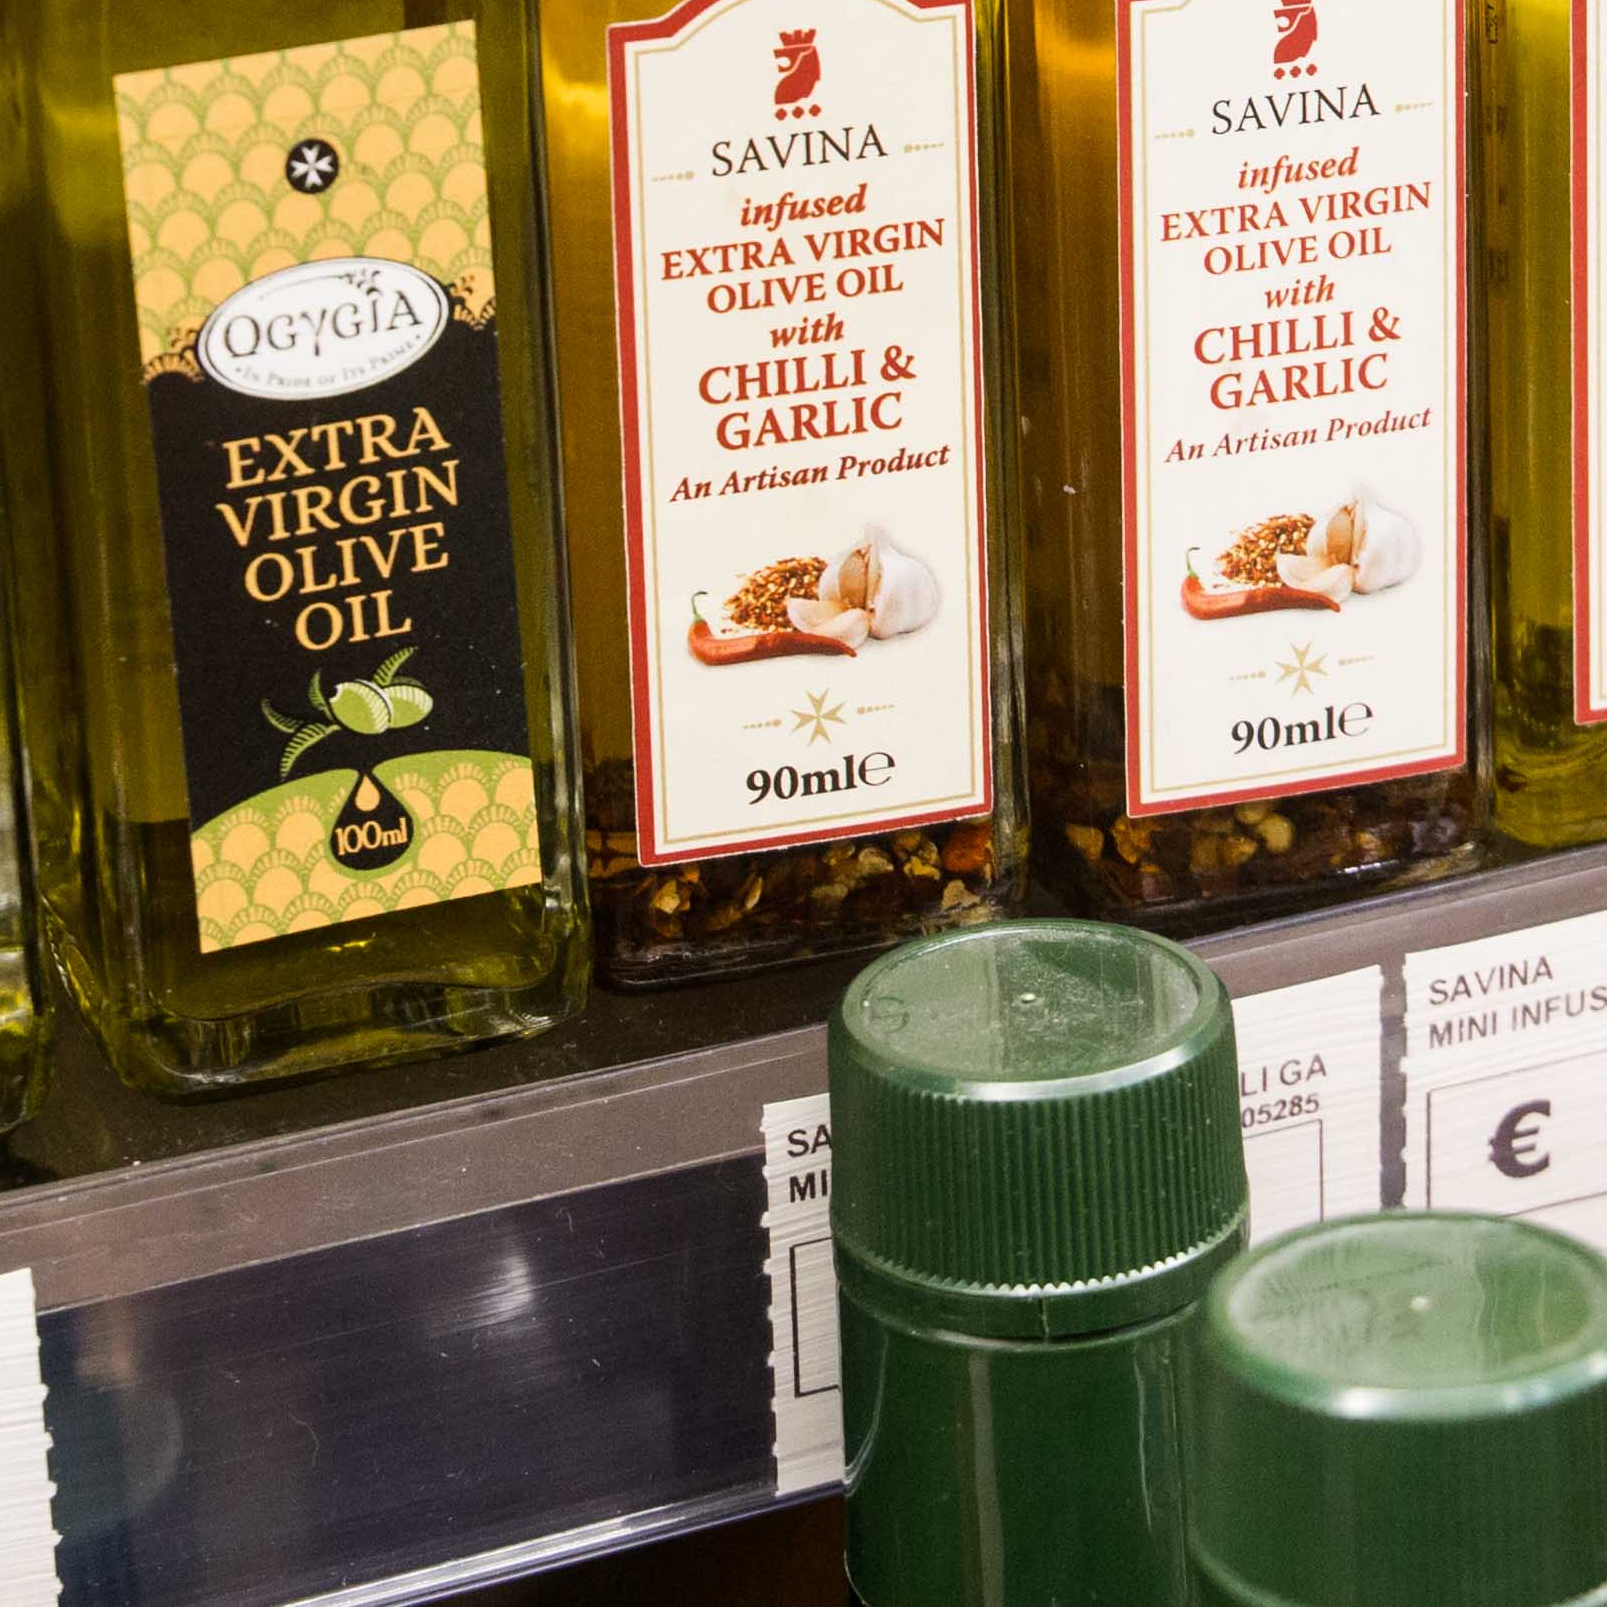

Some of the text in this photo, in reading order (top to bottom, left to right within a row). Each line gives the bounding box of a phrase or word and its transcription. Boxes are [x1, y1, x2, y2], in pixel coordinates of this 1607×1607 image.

[1211, 83, 1381, 136] SAVINA
[711, 124, 888, 177] SAVINA
[1237, 146, 1360, 194] infused
[740, 183, 868, 230] infused
[1160, 182, 1433, 243] EXTRA VIRGIN
[660, 219, 947, 281] EXTRA VIRGIN
[1203, 227, 1392, 276] OLIVE OIL
[707, 264, 905, 313] OLIVE OIL
[1264, 274, 1335, 310] with
[224, 290, 423, 358] OGYGIA
[770, 313, 844, 348] with
[1194, 306, 1402, 366] CHILLI &
[698, 345, 917, 405] CHILLI &
[1209, 353, 1388, 410] GARLIC
[716, 392, 904, 450] GARLIC
[1165, 407, 1433, 465] An Artisan Product
[222, 407, 451, 490] EXTRA
[669, 444, 951, 503] An Artisan Product
[215, 460, 459, 548] VIRGIN
[244, 521, 451, 603] OLIVE
[295, 589, 412, 651] OIL
[336, 816, 409, 856] 100ml
[1429, 956, 1554, 1006] SAVINA
[1429, 1011, 1498, 1049] MINI
[1241, 1054, 1327, 1096] LI GA
[1241, 1092, 1320, 1128] 05285
[788, 1124, 832, 1157] SA
[1488, 1098, 1552, 1179] €
[790, 1170, 828, 1203] MI
